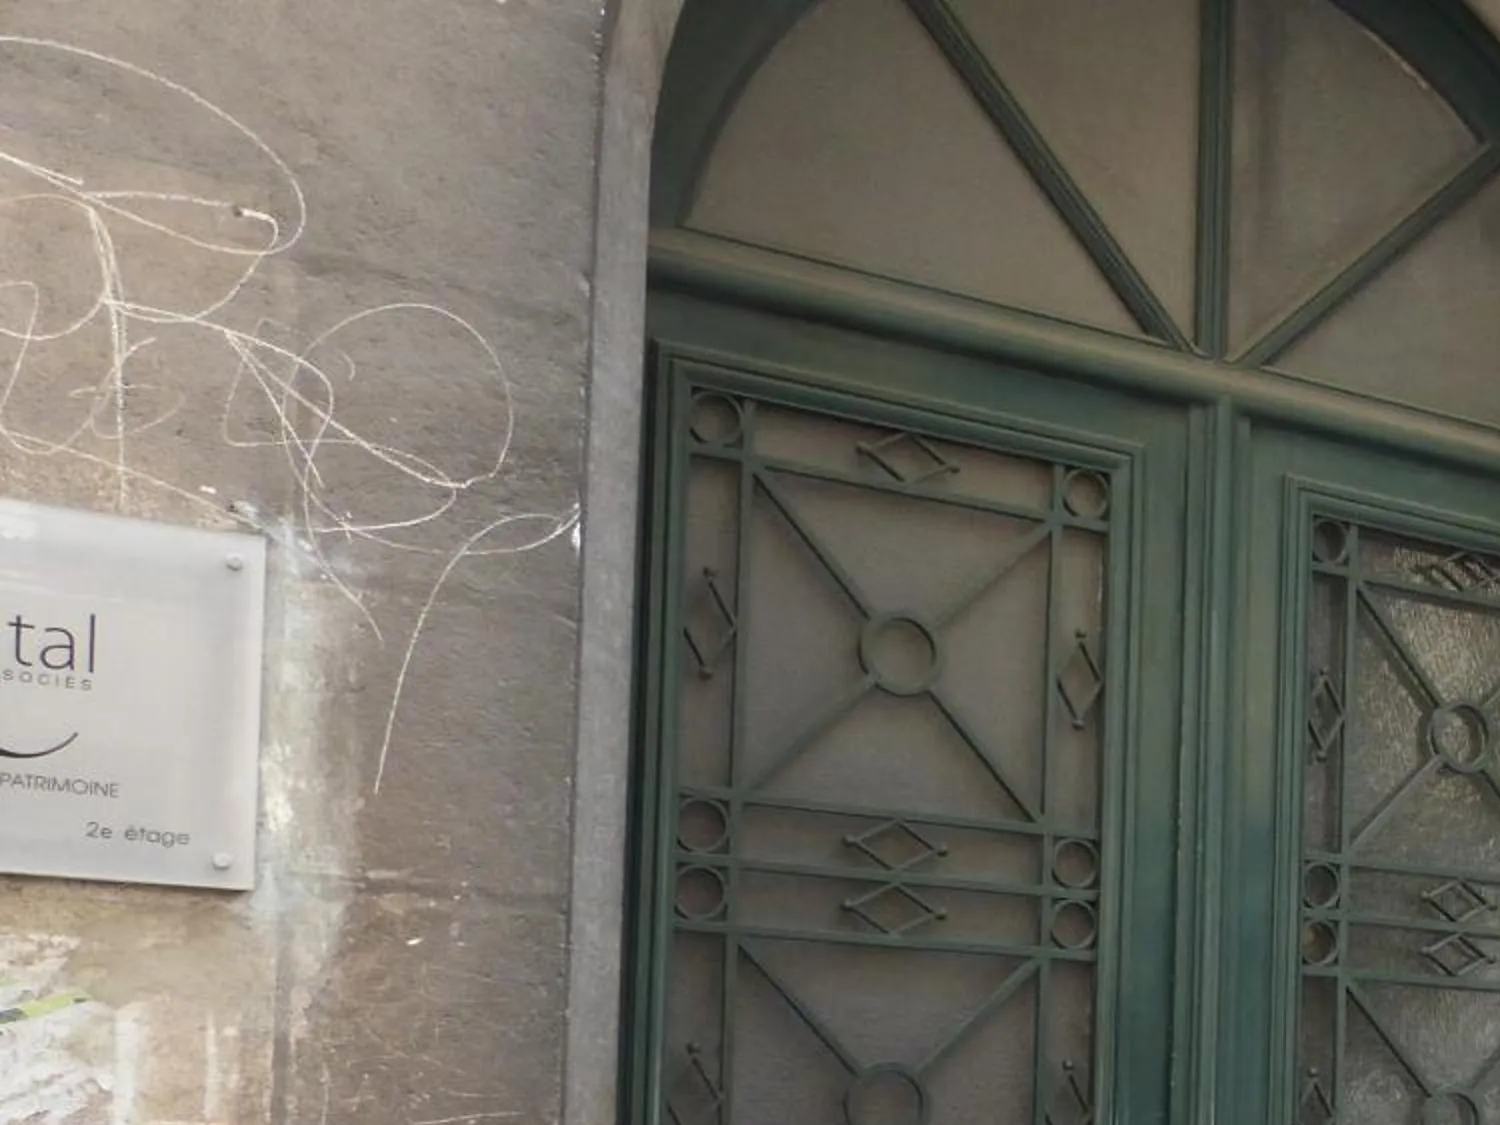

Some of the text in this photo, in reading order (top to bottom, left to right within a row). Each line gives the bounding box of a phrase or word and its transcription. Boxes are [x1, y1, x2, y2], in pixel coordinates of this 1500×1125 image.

[7, 614, 96, 674] tal
[0, 772, 120, 799] PATRIMOINE
[85, 821, 190, 849] 2e étage
